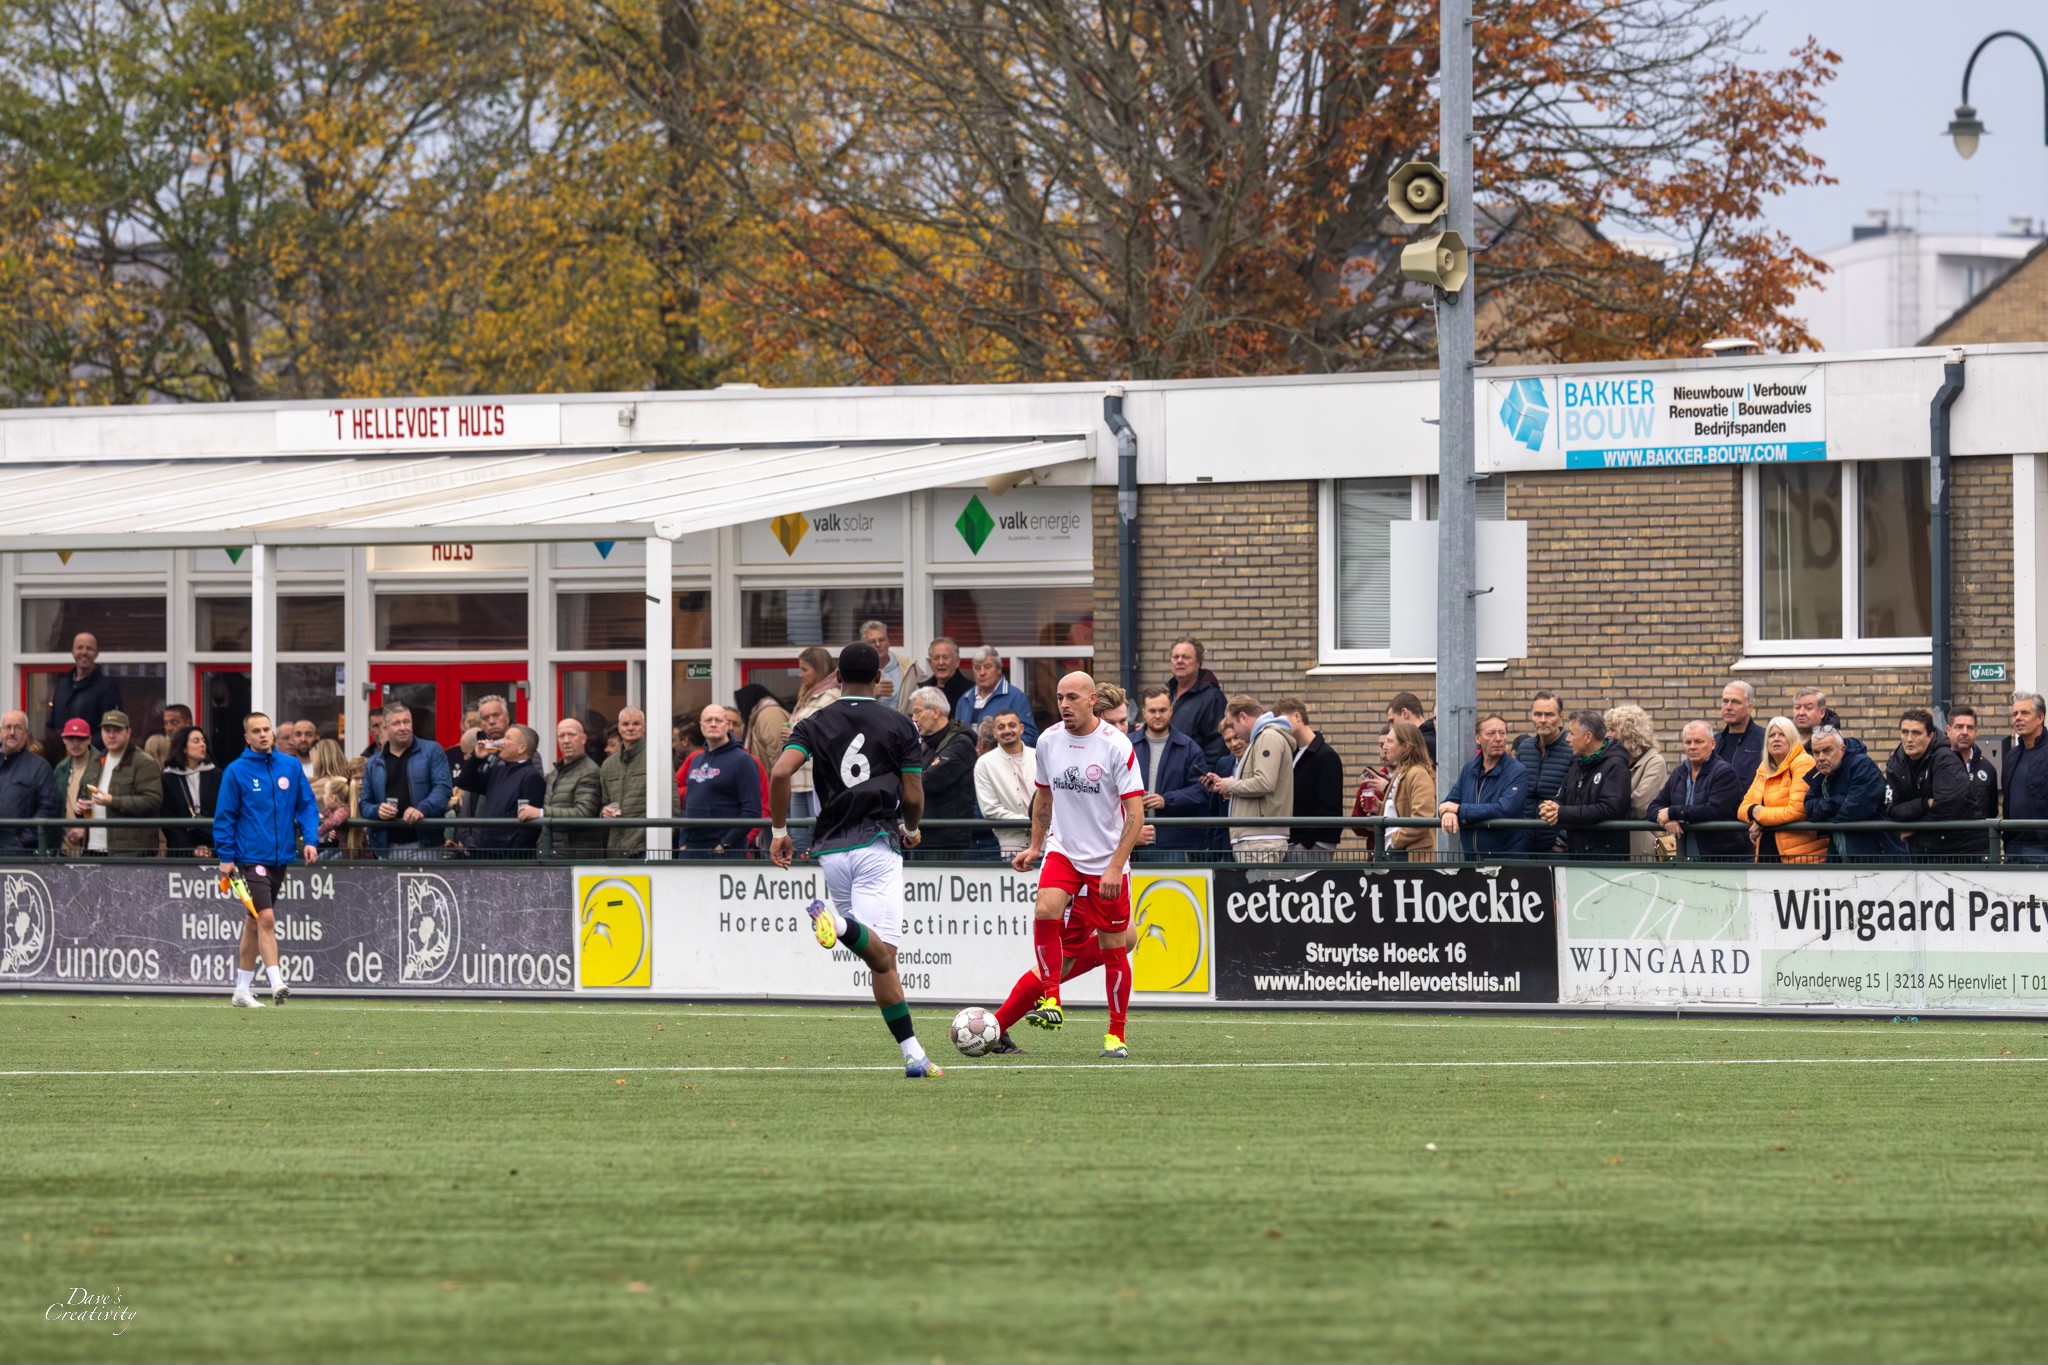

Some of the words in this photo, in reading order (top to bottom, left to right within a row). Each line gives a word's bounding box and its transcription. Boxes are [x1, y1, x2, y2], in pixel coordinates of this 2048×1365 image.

[1565, 380, 1655, 407] BAKKER
[1673, 385, 1744, 400] Nieuwbouw
[1753, 383, 1807, 398] Verbouw
[329, 409, 344, 441] 'T
[353, 407, 450, 440] HELLEVOET
[459, 405, 505, 437] HUIS
[1669, 404, 1729, 419] Renovatie
[1738, 401, 1812, 416] Bouwadvies
[1565, 407, 1656, 441] BOUW
[1694, 420, 1787, 437] Bedrijfspanden
[1603, 444, 1787, 467] WWW.BAKKER-BOUW.COM
[813, 513, 841, 531] valk
[843, 513, 875, 531] solar
[999, 511, 1028, 530] valk
[1030, 511, 1081, 534] energie
[1981, 668, 1995, 676] AED
[840, 733, 871, 788] 6
[311, 873, 336, 900] 94
[719, 874, 747, 900] De
[753, 873, 816, 901] Arend
[950, 875, 992, 903] Den
[1226, 879, 1357, 924] eetcafe
[1358, 876, 1385, 924] 't
[1393, 878, 1545, 924] Hoeckie
[720, 912, 798, 933] Horeca
[1773, 888, 1955, 942] Wijngaard
[346, 942, 383, 983] de
[1305, 941, 1380, 967] Struytse
[1383, 942, 1440, 963] Hoeck
[1444, 941, 1467, 963] 16
[1569, 947, 1750, 979] WIJNGAARD
[190, 954, 235, 981] 0181
[1253, 971, 1521, 991] www.hoeckie-hellevoetsluis.nl
[1576, 985, 1638, 996] PARTY
[1655, 986, 1744, 998] SERVICE
[1776, 971, 1862, 991] Polyanderweg
[1866, 973, 1880, 988] 15
[1894, 973, 1925, 989] 3218
[1928, 974, 1944, 989] AS
[1948, 973, 2007, 990] Heenvliet
[2021, 975, 2029, 990] T
